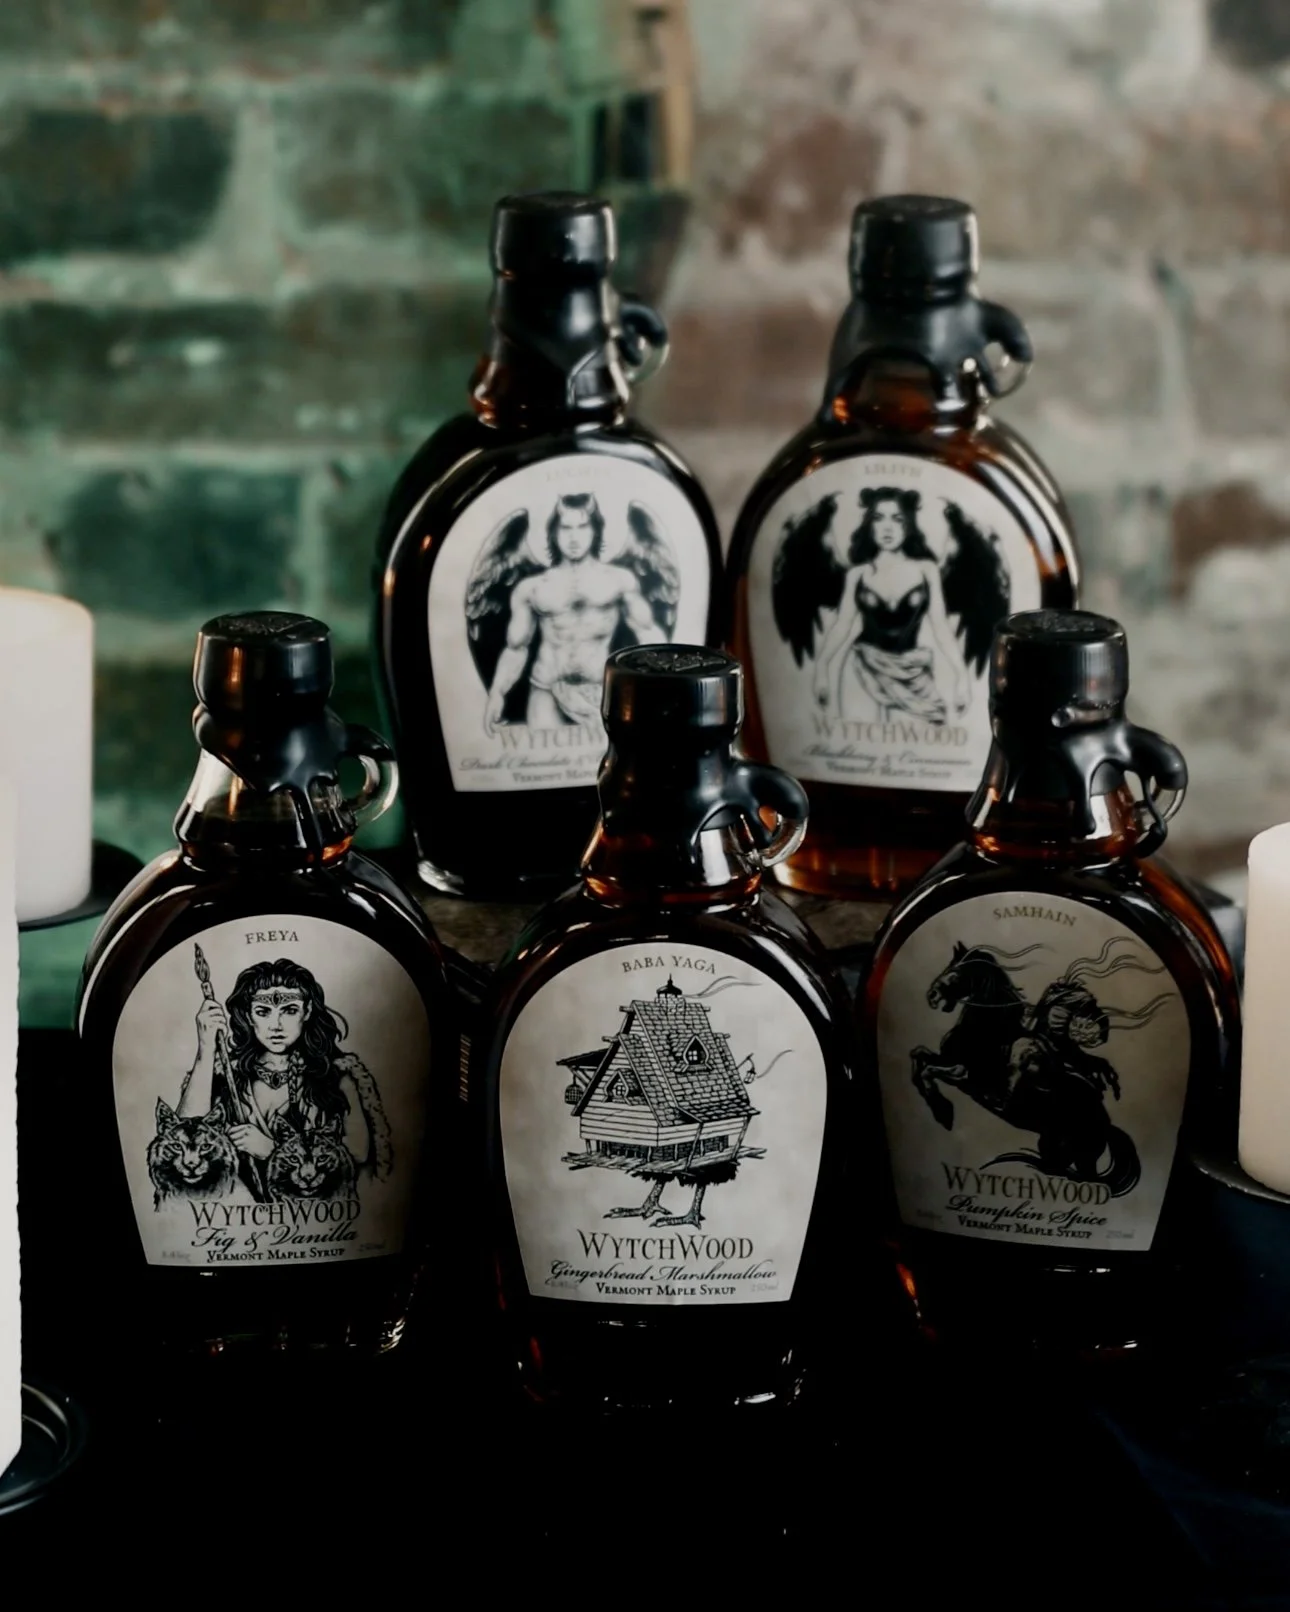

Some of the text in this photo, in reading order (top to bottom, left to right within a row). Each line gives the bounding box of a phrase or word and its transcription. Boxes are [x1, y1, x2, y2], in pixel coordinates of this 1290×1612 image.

[993, 905, 1077, 927] SAMHAIN
[245, 930, 299, 945] FREYA
[622, 955, 716, 975] BABA YAGA
[941, 1162, 1111, 1206] WYTCHWOOD
[188, 1199, 361, 1227] WYTCHWOOD
[946, 1194, 1108, 1229] Pumpkin Spice
[191, 1222, 359, 1253] Fig & Vanilla
[957, 1214, 1011, 1233] VERMONT
[1015, 1223, 1053, 1237] MAPLE
[1056, 1227, 1092, 1239] SYRUP
[206, 1246, 345, 1263] VERMONT MAPLE SYRUP
[576, 1229, 754, 1260] WYTCHWOOD
[545, 1260, 651, 1287] Gingerbread
[650, 1259, 777, 1282] Marshmallow
[595, 1282, 737, 1296] VERMONT MAPLE SYRUP
